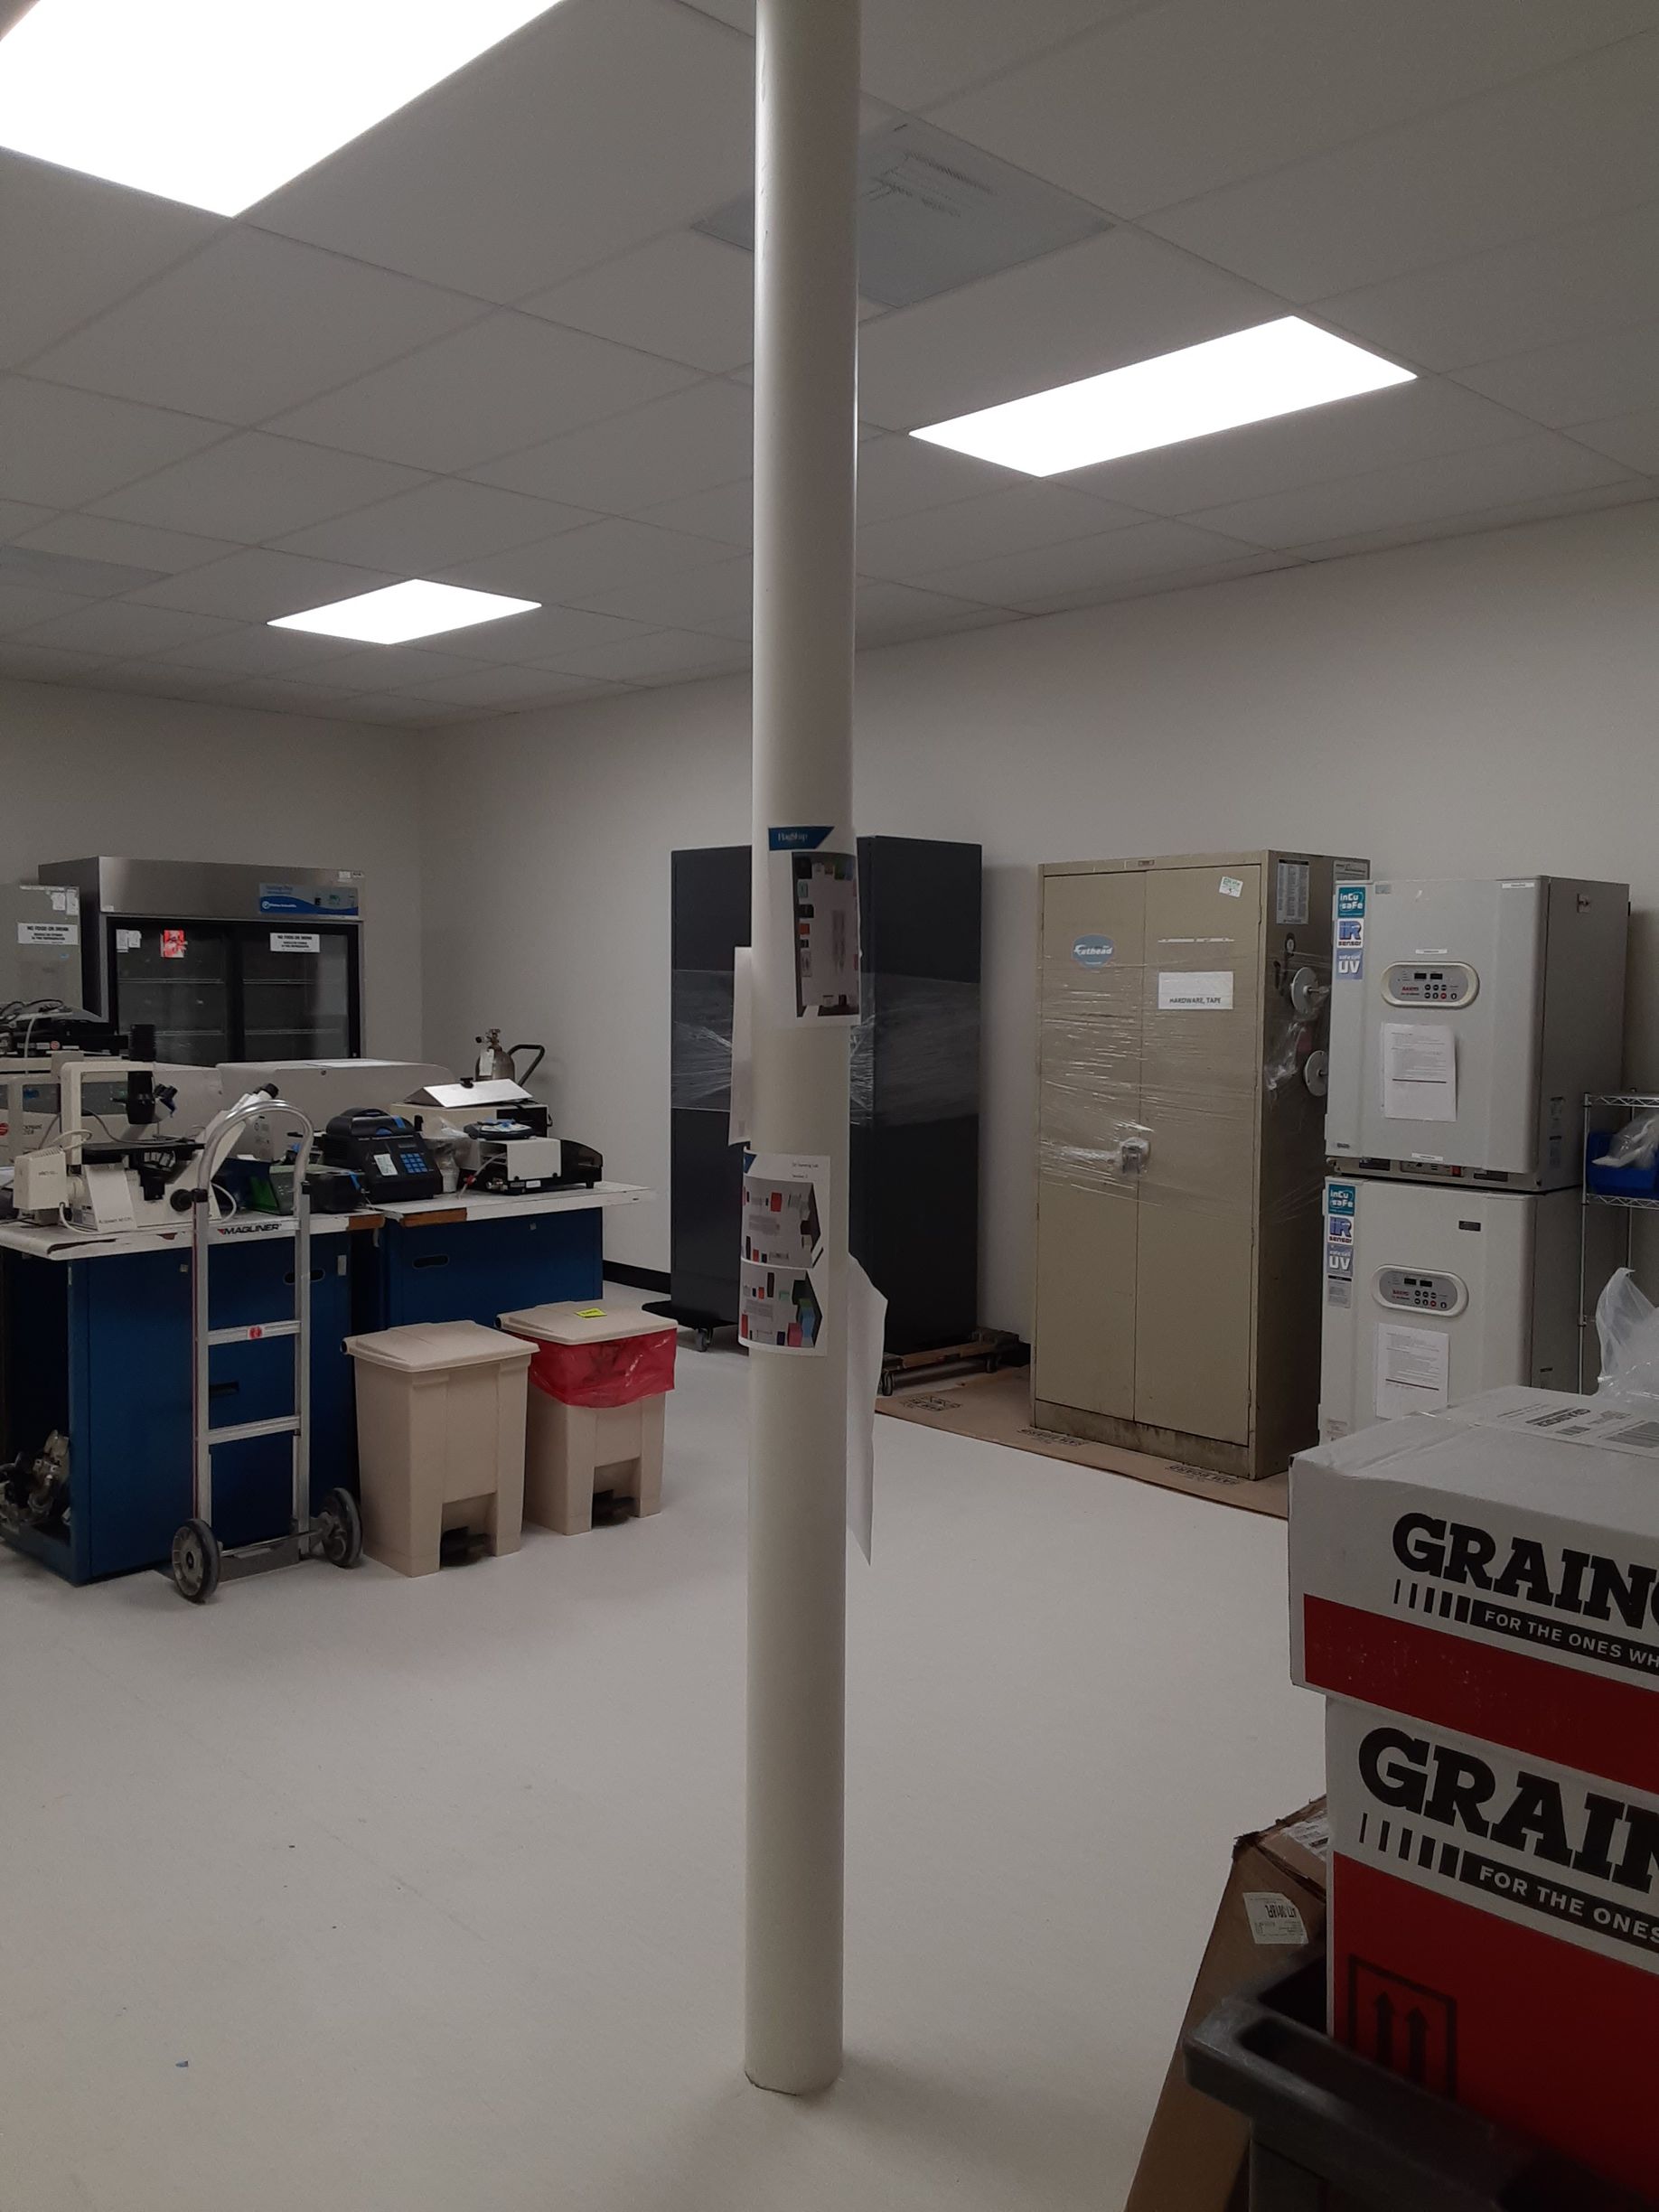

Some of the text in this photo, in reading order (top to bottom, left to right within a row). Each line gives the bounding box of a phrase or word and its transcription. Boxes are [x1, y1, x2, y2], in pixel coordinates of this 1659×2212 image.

[1338, 960, 1361, 974] UV
[1169, 997, 1205, 1005] HARDWARE,
[224, 1223, 279, 1235] MAGLINER
[1329, 1256, 1351, 1271] UV
[1392, 1513, 1659, 1629] GRAIN
[1484, 1610, 1522, 1632] FOR
[1528, 1621, 1563, 1643] THE
[1569, 1633, 1623, 1658] ONES
[1479, 1865, 1529, 1897] FOR
[1537, 1886, 1585, 1917] THE
